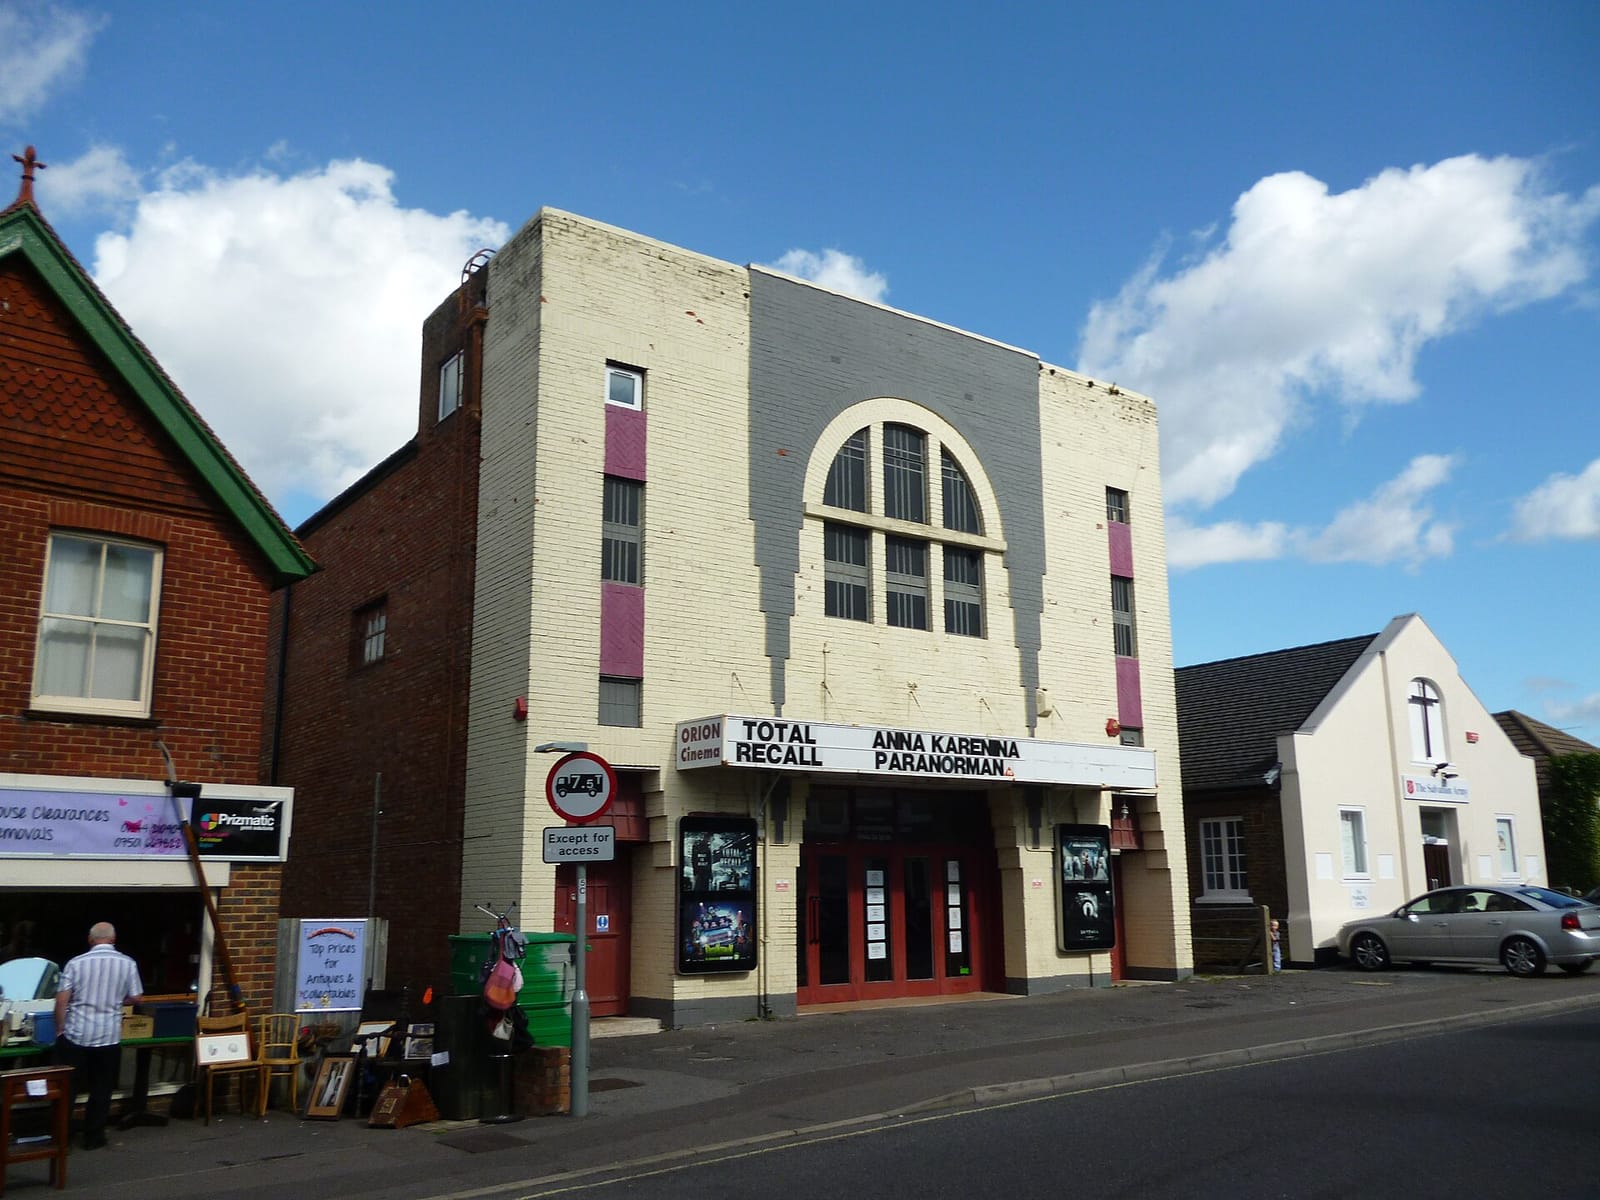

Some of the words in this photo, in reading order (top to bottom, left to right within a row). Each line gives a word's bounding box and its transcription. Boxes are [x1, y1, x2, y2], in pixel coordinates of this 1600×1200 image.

[681, 722, 720, 743] ORION
[742, 720, 817, 745] TOTAL
[872, 730, 926, 752] ANNA
[681, 746, 720, 762] Cinema
[736, 742, 823, 766] RECALL
[875, 752, 1005, 776] PARANORMAN
[32, 806, 110, 822] Clearances
[218, 813, 275, 826] Prizmatic
[548, 833, 588, 844] Except
[593, 832, 610, 842] for
[559, 847, 599, 856] access
[309, 943, 325, 957] Top
[327, 943, 357, 954] Prices
[324, 958, 340, 968] for
